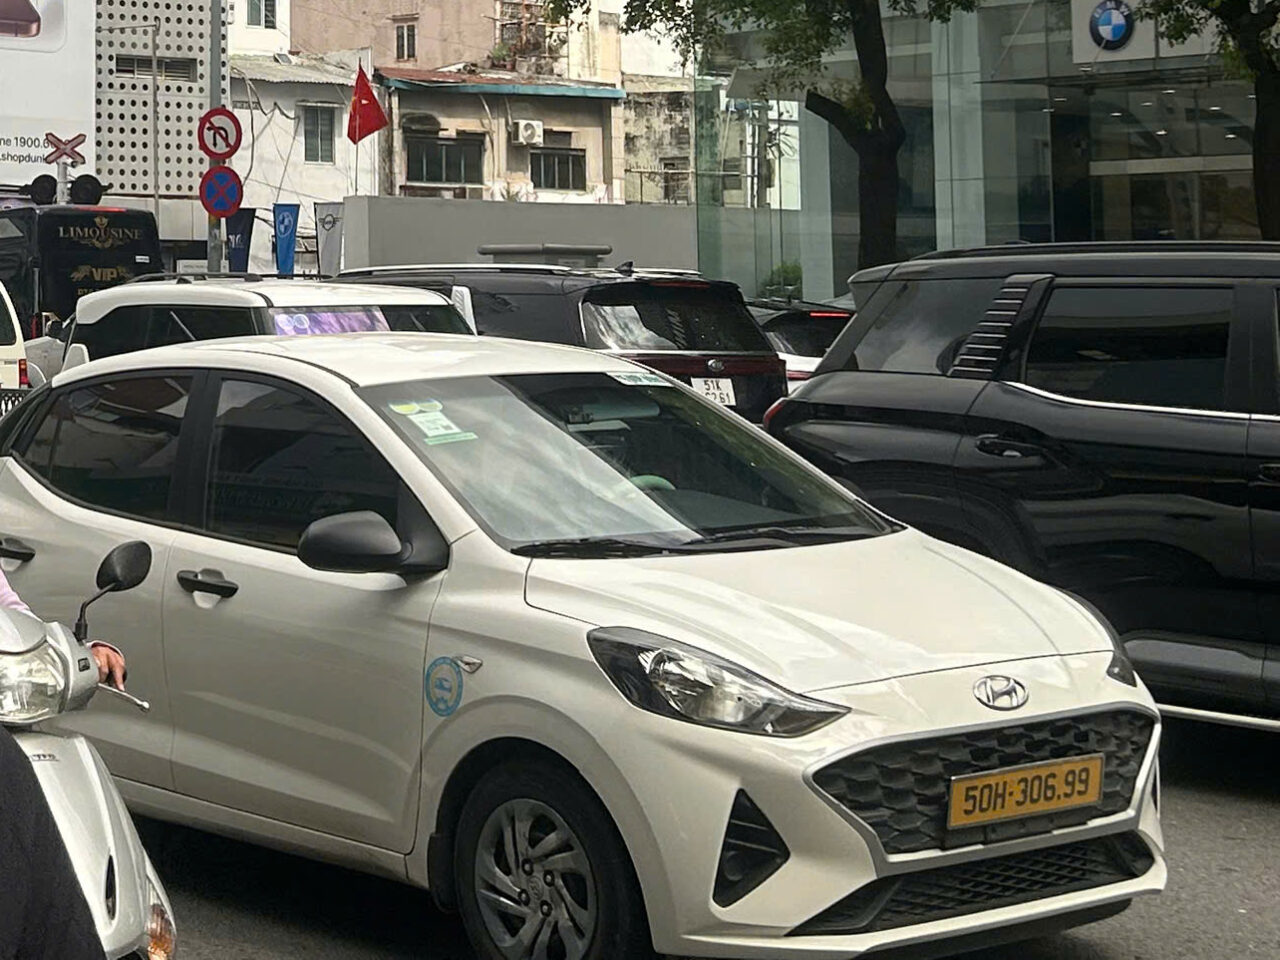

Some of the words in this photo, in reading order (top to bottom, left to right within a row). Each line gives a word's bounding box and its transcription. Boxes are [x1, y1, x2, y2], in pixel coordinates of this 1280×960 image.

[14, 137, 55, 149] 1900.6
[59, 226, 143, 240] LIMOUSINE
[92, 268, 118, 281] VIP
[704, 380, 721, 392] 51K
[963, 766, 1091, 816] 50H-306.99
